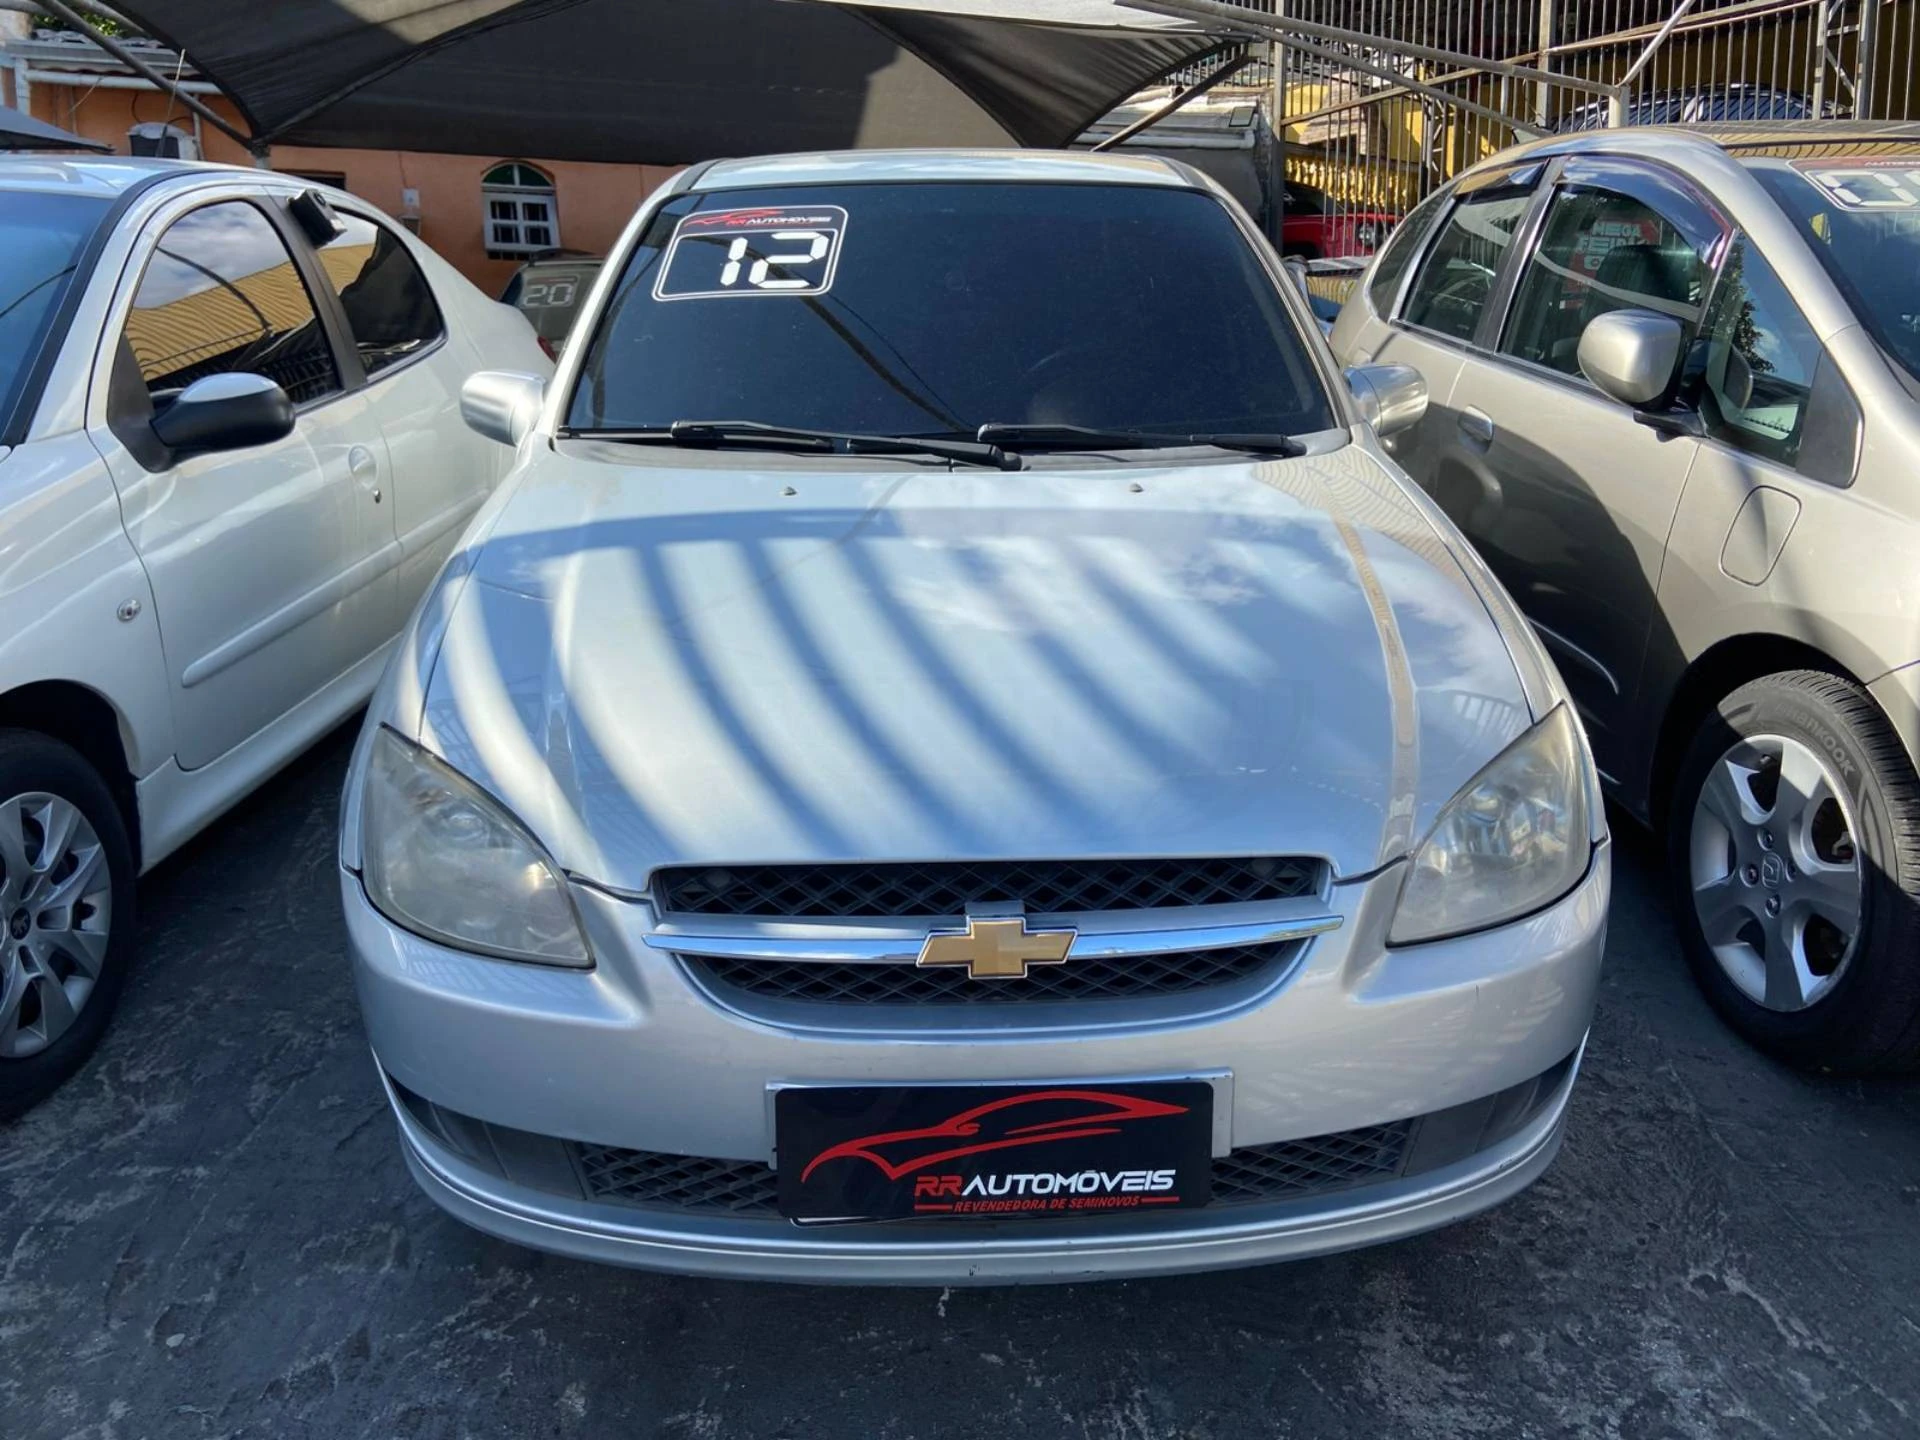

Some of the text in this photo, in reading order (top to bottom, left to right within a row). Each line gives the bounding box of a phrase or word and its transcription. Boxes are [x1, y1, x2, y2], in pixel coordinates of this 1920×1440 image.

[1814, 170, 1920, 206] 0
[720, 231, 829, 288] 12
[524, 283, 573, 306] 20
[953, 1196, 1139, 1212] REVENDEDORA DE SEMINOVOS
